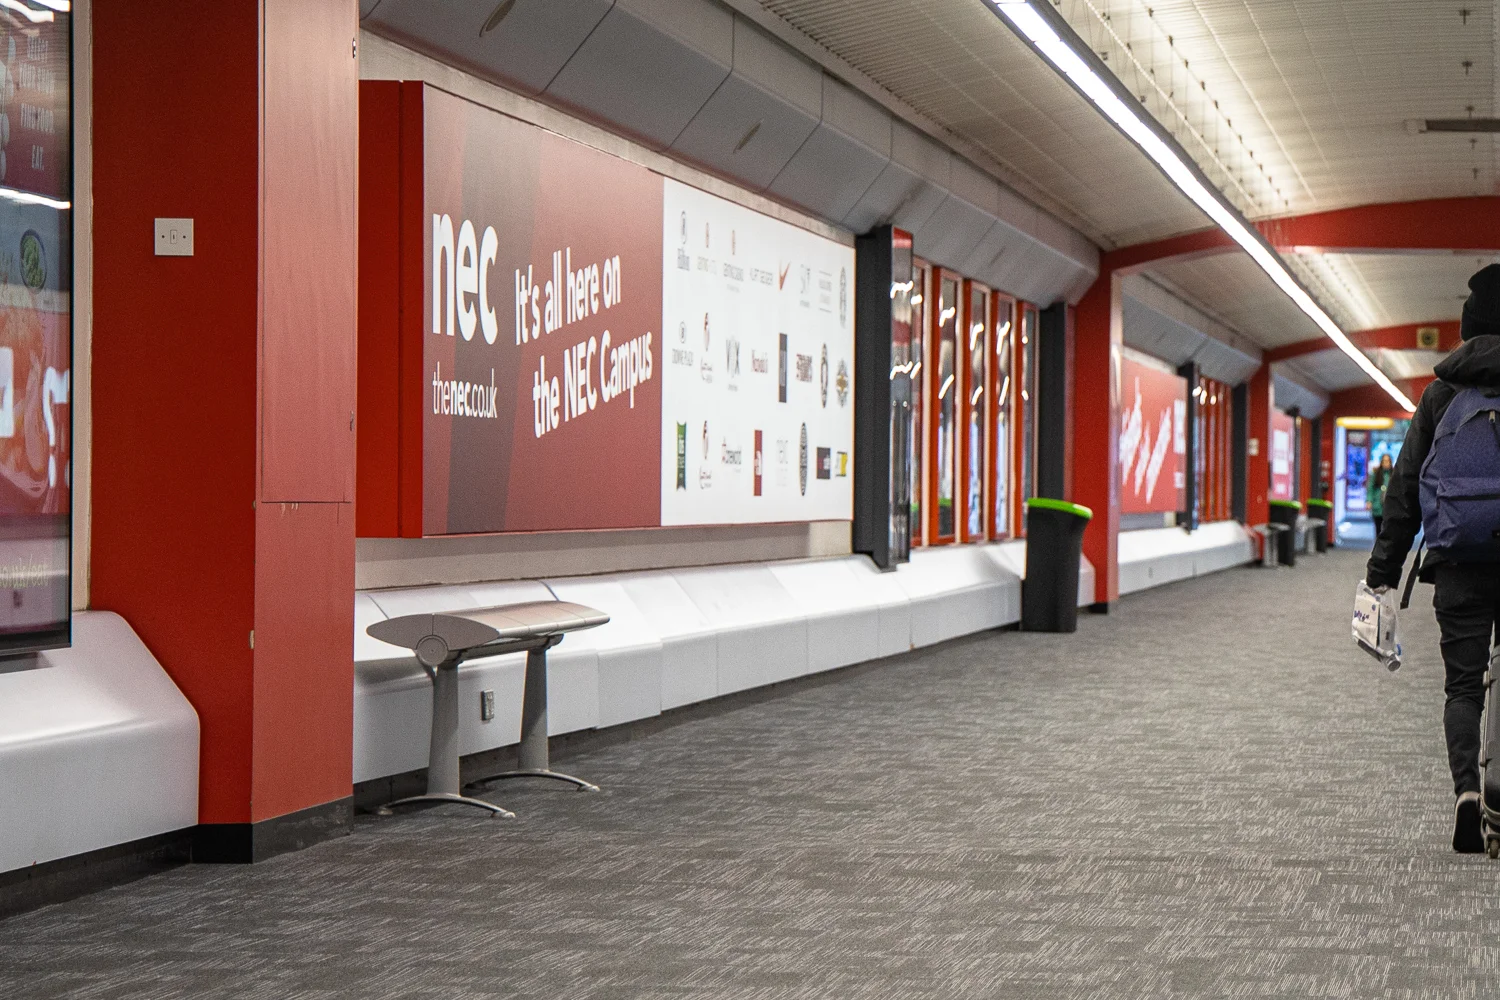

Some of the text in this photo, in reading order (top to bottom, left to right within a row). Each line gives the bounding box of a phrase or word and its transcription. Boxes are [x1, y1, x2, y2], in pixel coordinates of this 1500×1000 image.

[432, 213, 498, 345] nec
[515, 247, 621, 345] It's all here on
[432, 361, 498, 418] thenec.co.uk
[533, 329, 653, 438] the NEC Campus
